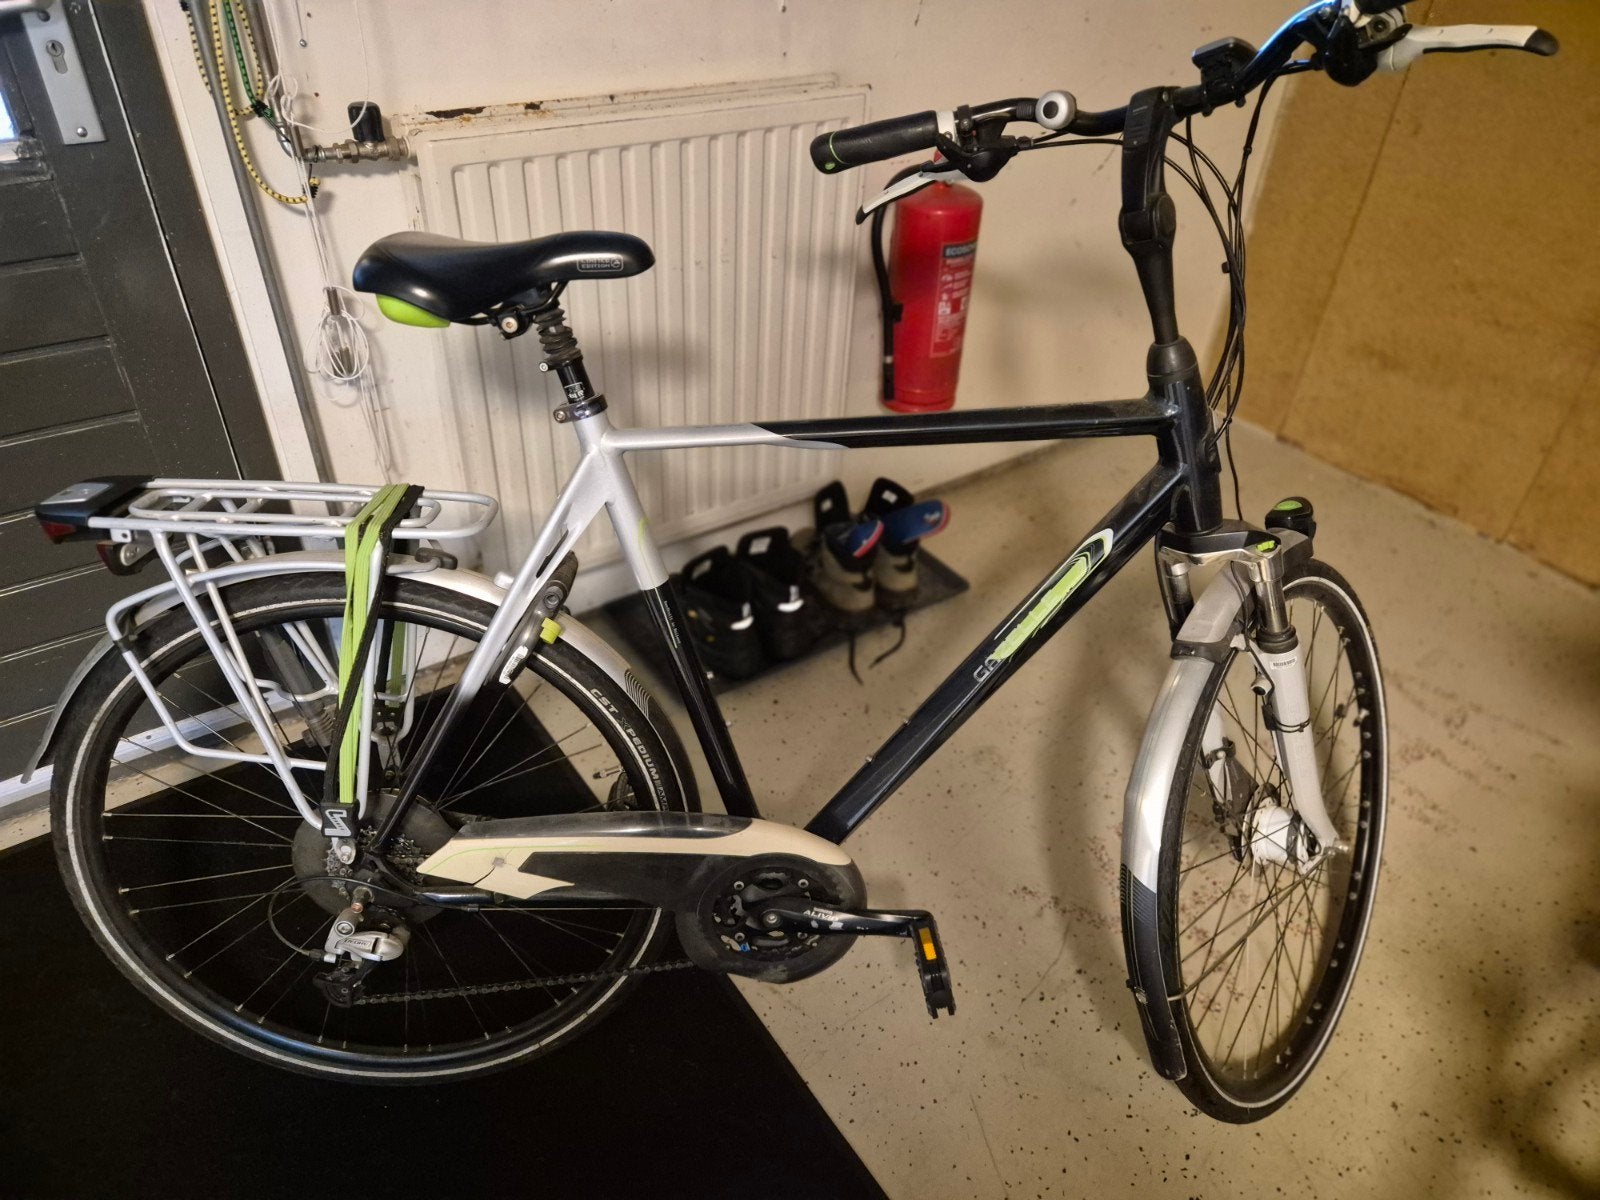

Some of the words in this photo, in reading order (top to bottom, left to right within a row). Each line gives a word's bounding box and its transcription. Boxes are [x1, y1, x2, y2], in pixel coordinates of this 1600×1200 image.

[590, 688, 618, 713] CST
[619, 717, 661, 781] XPEDIUM
[803, 909, 839, 922] ALIVIO
